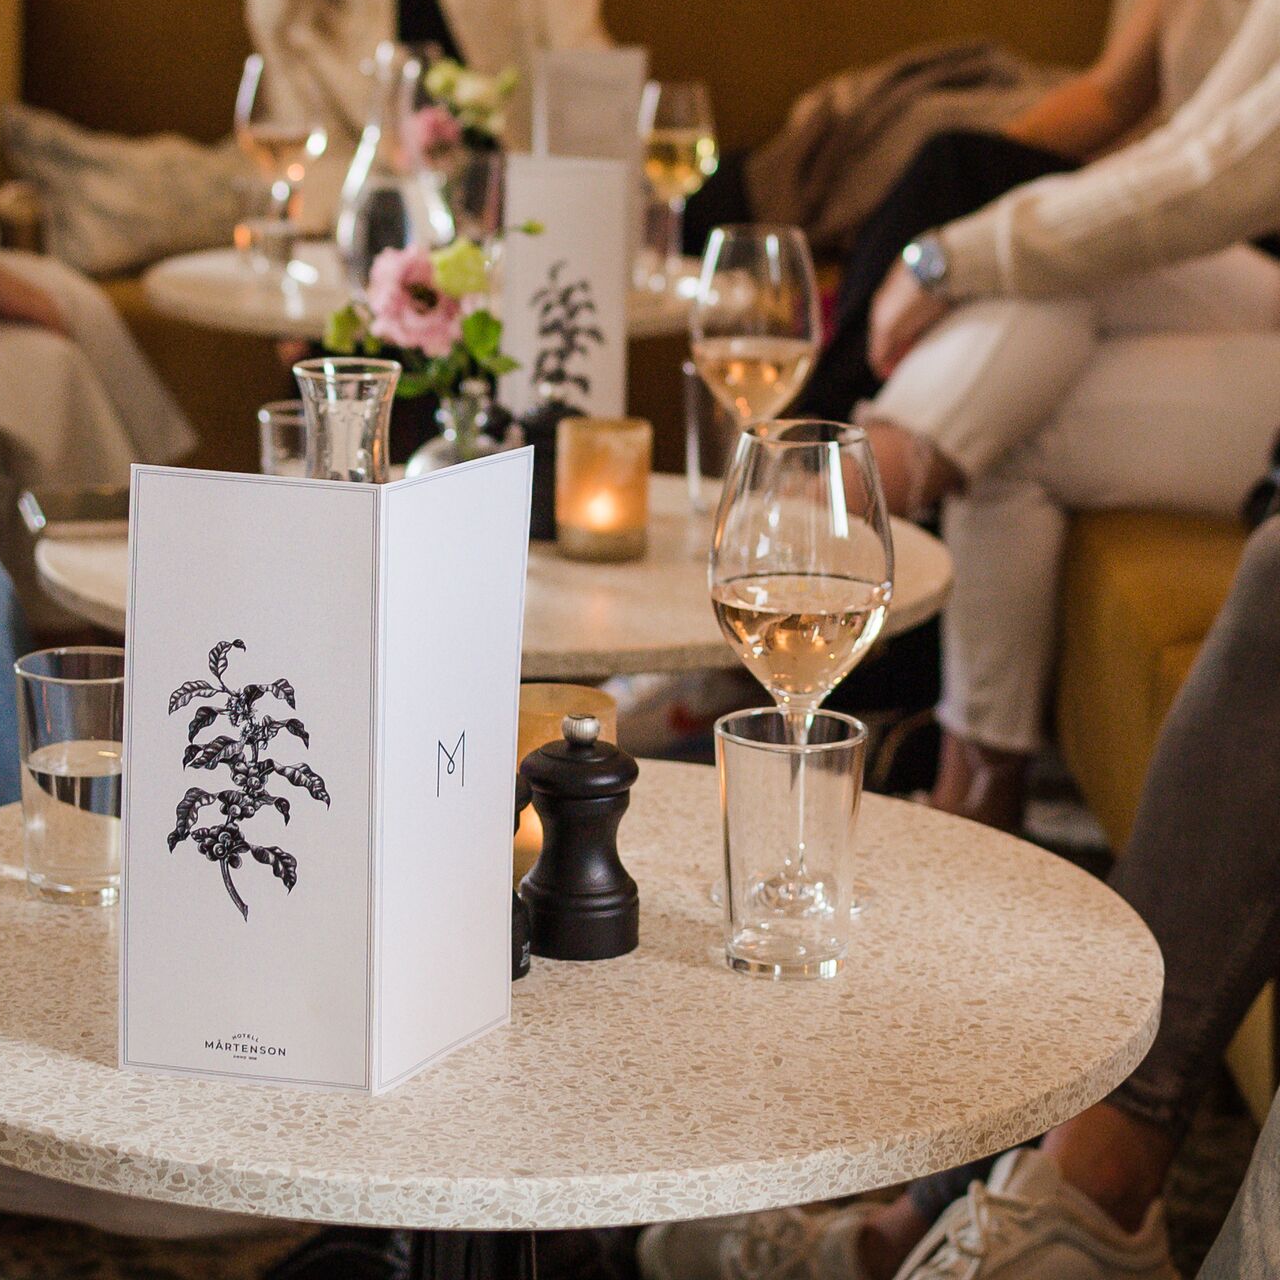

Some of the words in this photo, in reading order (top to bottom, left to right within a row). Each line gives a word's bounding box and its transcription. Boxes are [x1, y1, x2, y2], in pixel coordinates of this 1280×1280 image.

[436, 729, 466, 798] M
[231, 1033, 260, 1043] HOTELL
[204, 1039, 287, 1057] MÅRTENSON
